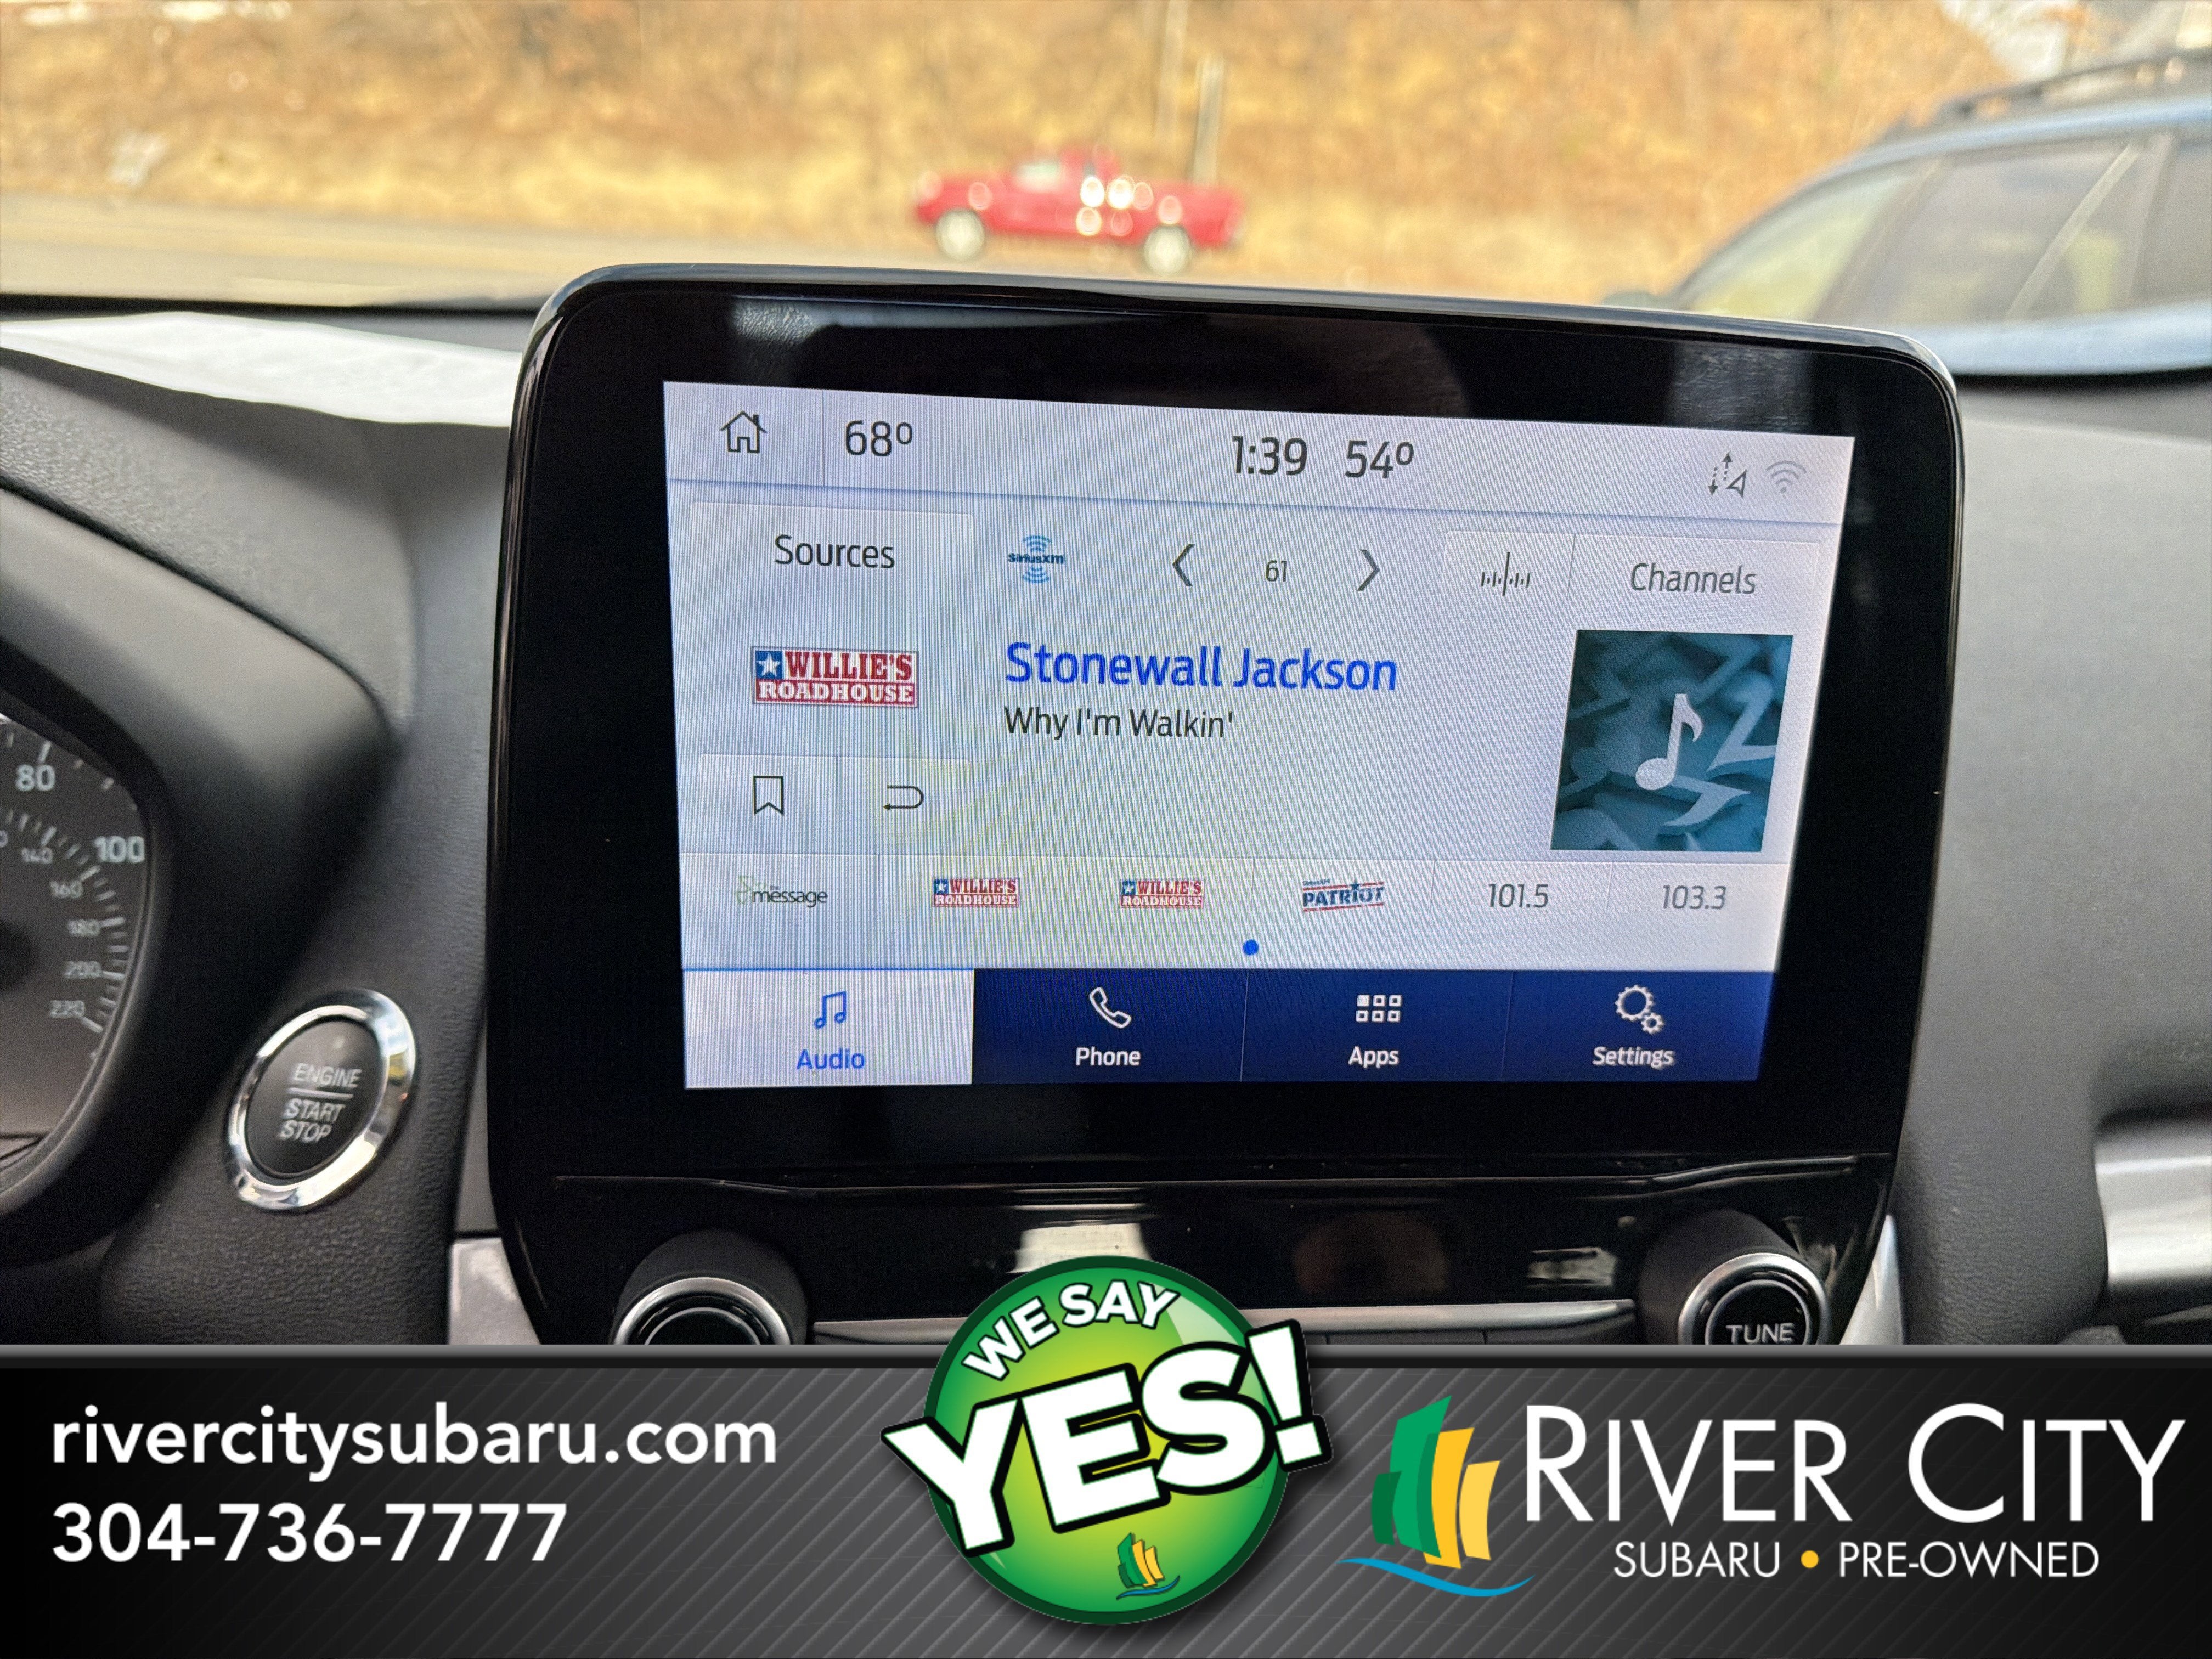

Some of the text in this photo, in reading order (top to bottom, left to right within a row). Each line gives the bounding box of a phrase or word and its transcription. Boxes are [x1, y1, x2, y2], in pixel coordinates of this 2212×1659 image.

[1232, 436, 1308, 476] 1:39
[774, 534, 895, 569] Sources
[1265, 560, 1288, 583] 61
[1629, 562, 1757, 595] Channels
[785, 651, 912, 681] WILLIE'S
[1005, 642, 1397, 691] Stonewall Jackson
[758, 680, 914, 703] ROADHOUSE
[1005, 707, 1233, 741] Why I'm Walkin'
[16, 764, 55, 792] 80
[21, 847, 53, 864] 140
[94, 836, 145, 864] 100
[950, 878, 1017, 894] WILLIE'S
[1488, 884, 1549, 909] 101.5
[1662, 885, 1726, 909] 103.3
[752, 891, 828, 908] message
[935, 894, 1017, 905] ROADHOUSE
[796, 1049, 866, 1070] Audio
[1076, 1047, 1141, 1066] Phone
[1348, 1046, 1400, 1068] Apps
[1592, 1047, 1675, 1069] Settings
[292, 1063, 363, 1088] ENGINE
[282, 1098, 347, 1124] START
[278, 1119, 332, 1144] STOP
[1725, 1323, 1794, 1344] TUNE
